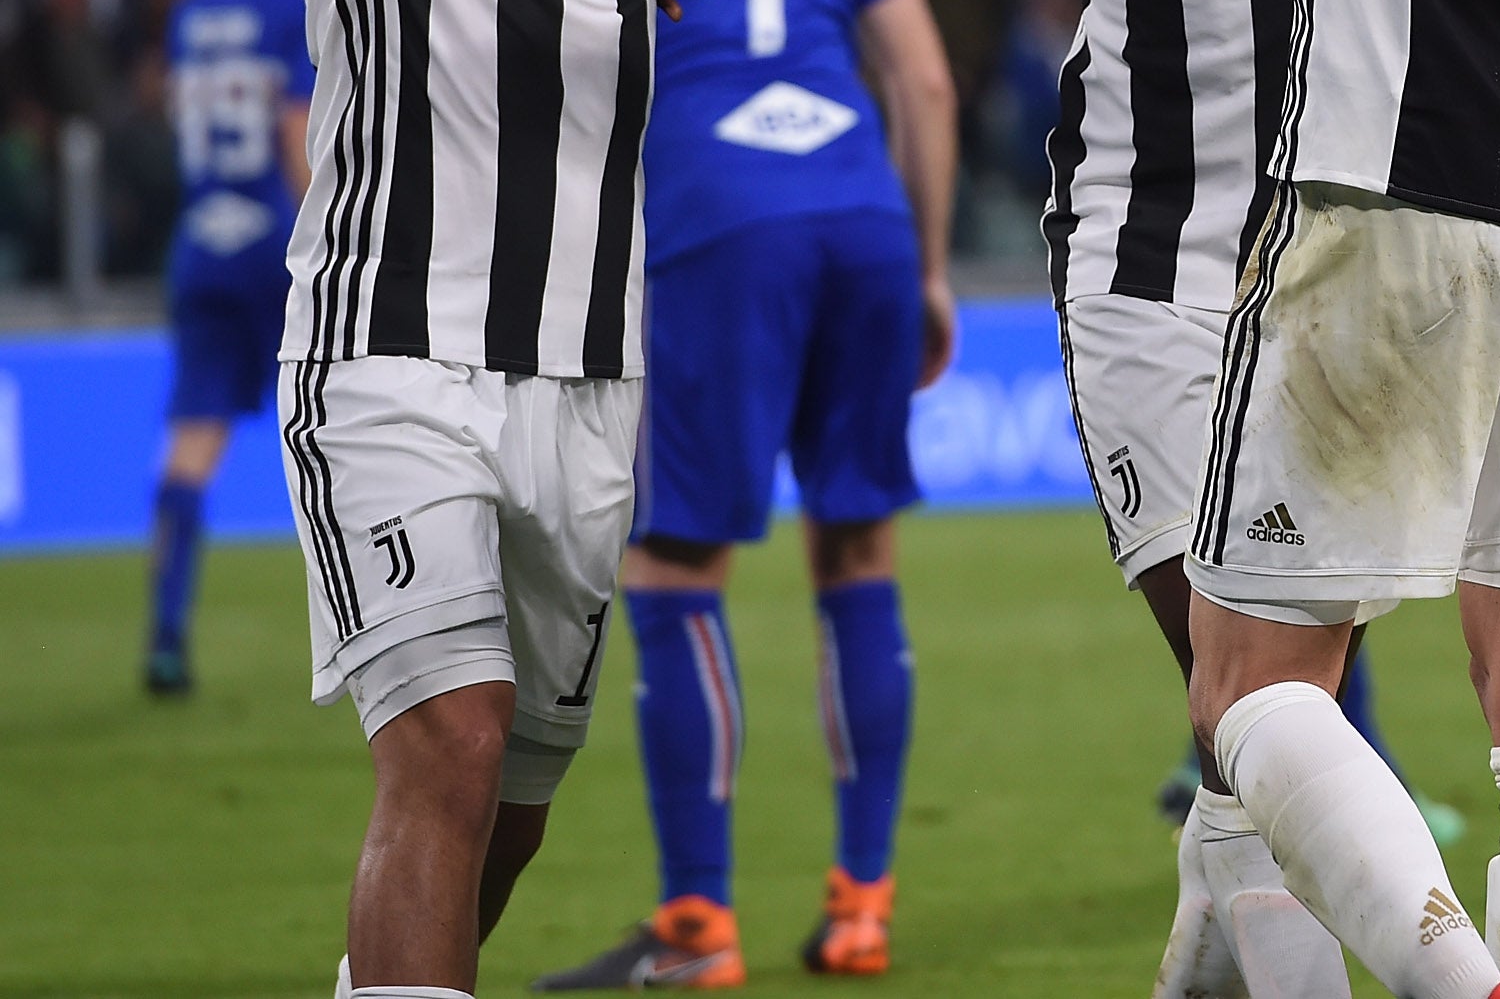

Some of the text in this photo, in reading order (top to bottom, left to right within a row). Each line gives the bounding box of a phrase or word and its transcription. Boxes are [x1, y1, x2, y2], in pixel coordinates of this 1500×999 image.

[368, 514, 403, 538] JUVENTUS
[1246, 525, 1306, 547] adidas
[1419, 913, 1473, 947] adida
